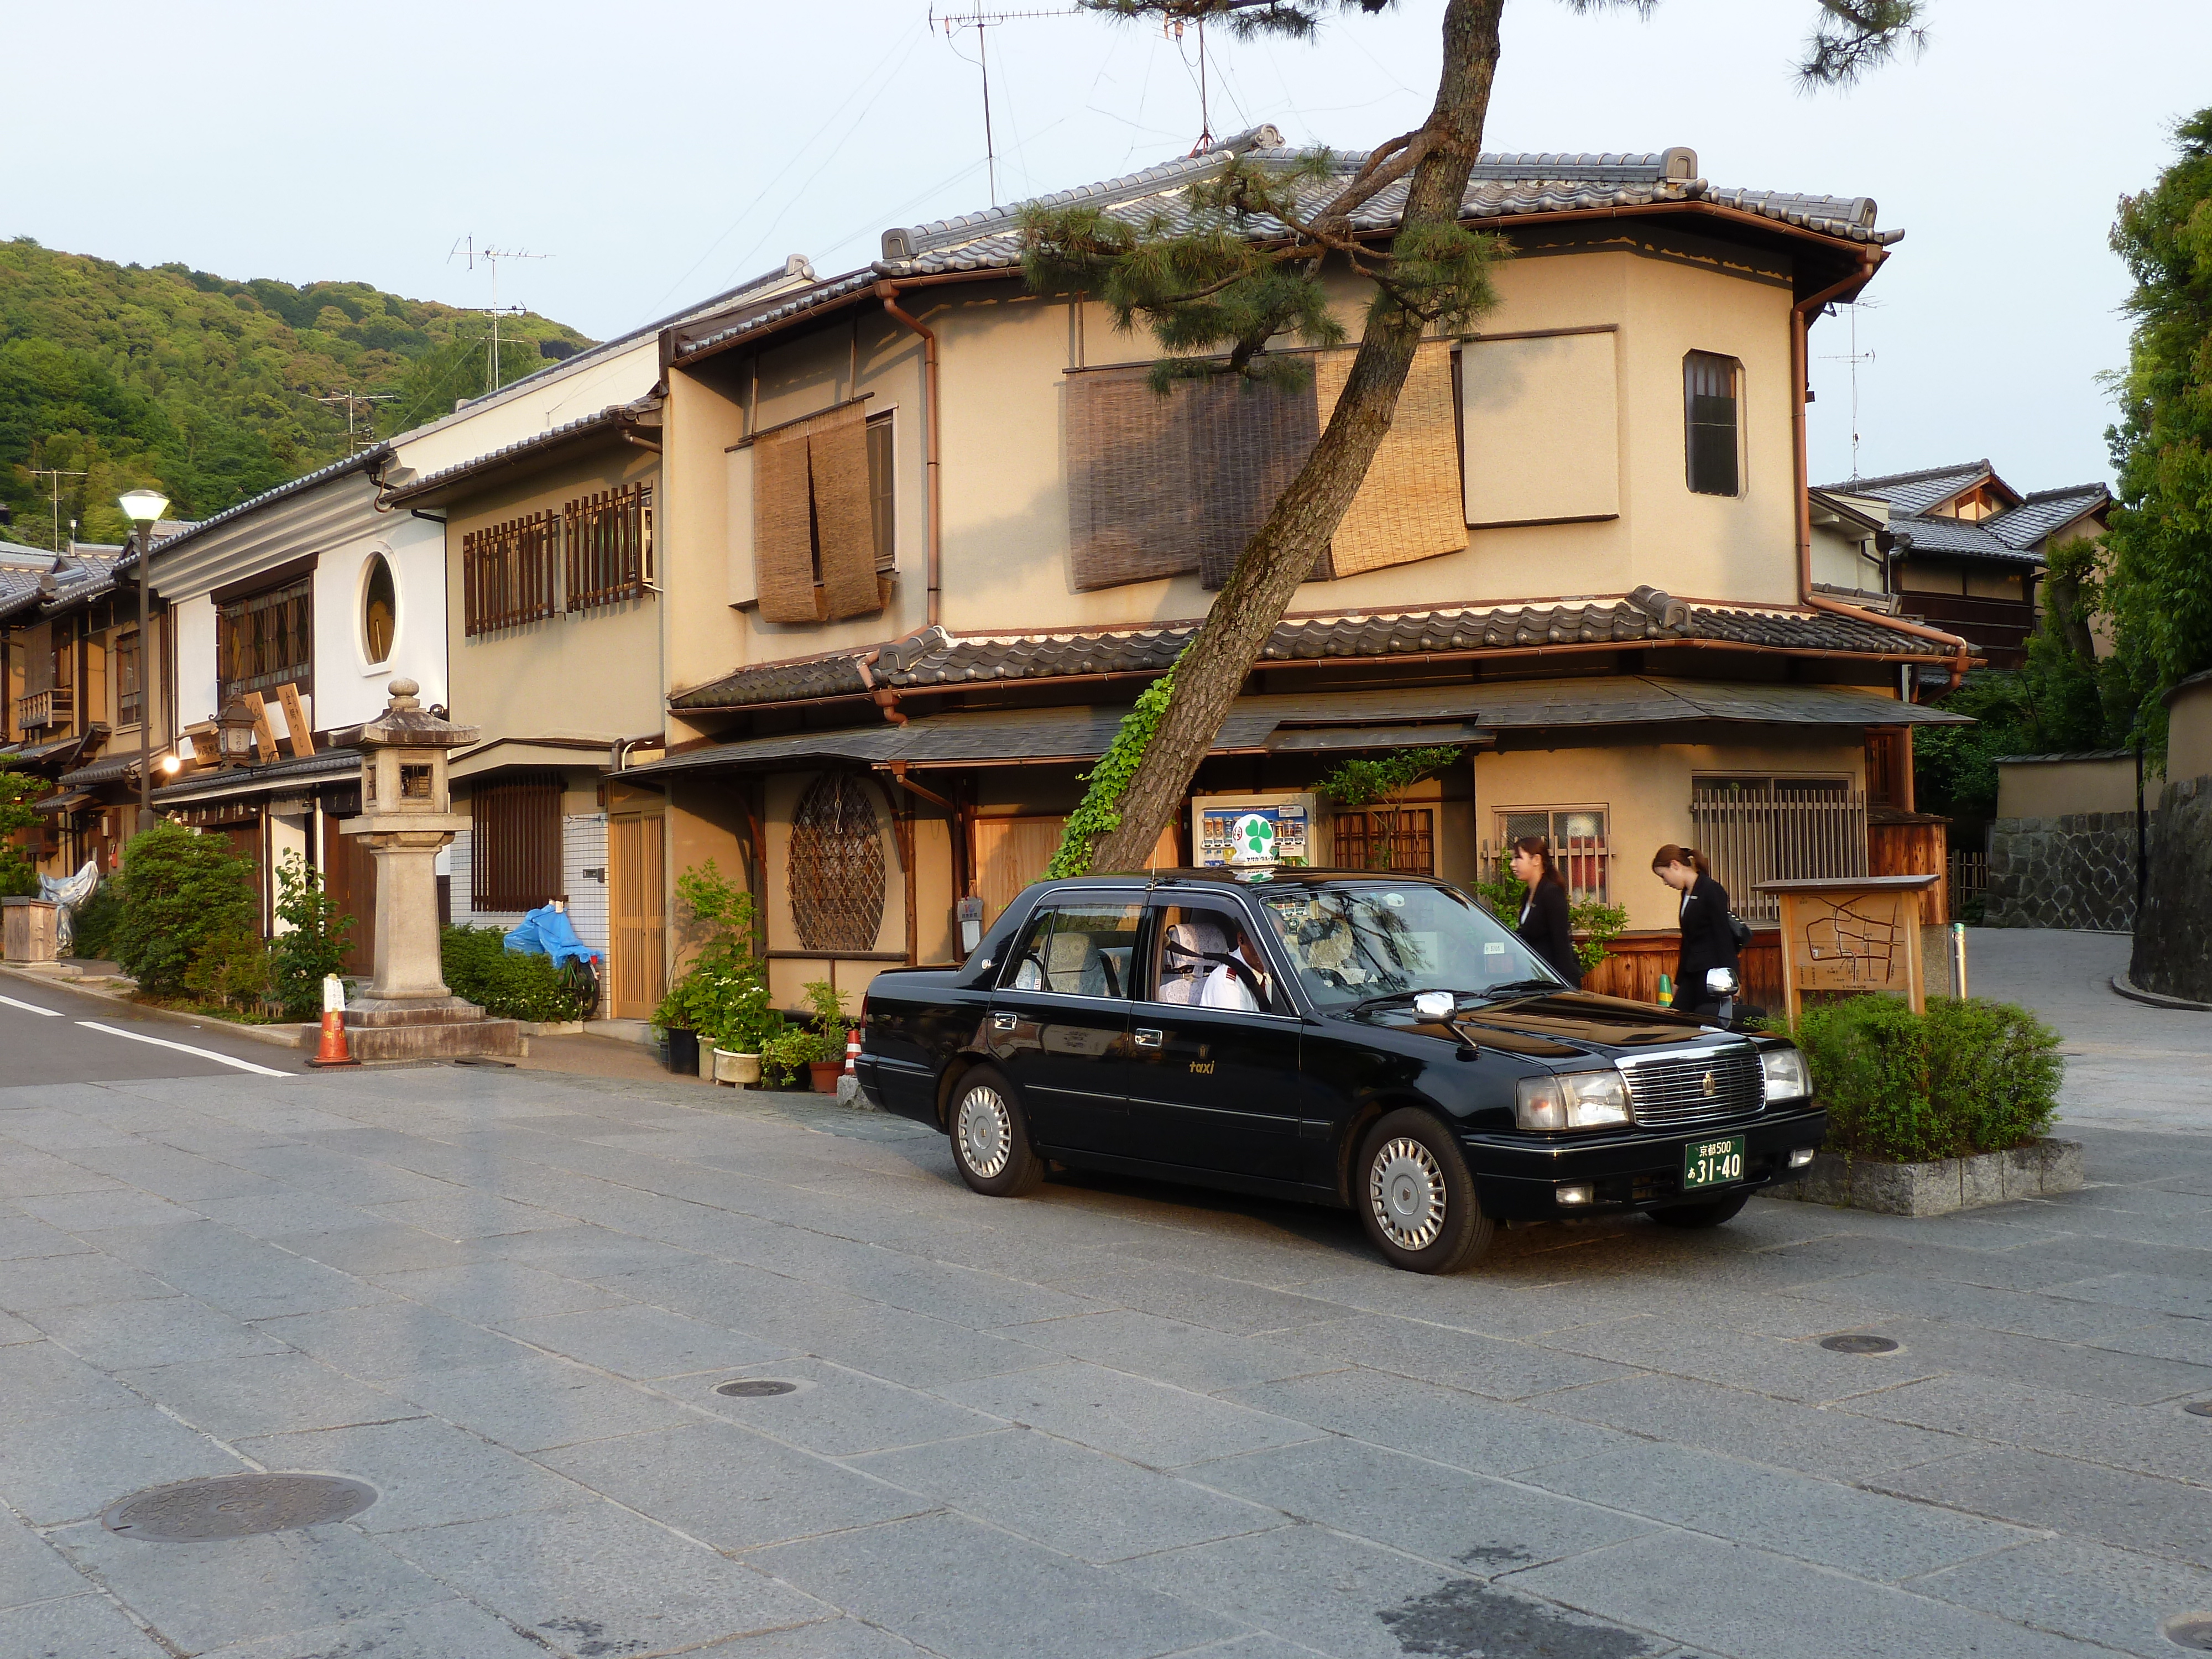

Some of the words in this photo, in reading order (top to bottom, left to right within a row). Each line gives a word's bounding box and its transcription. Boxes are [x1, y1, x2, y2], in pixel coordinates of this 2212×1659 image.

[1190, 1060, 1214, 1074] taxi
[1699, 1141, 1731, 1157] 京都500
[1688, 1167, 1695, 1179] あ
[1697, 1154, 1740, 1182] 31-40
